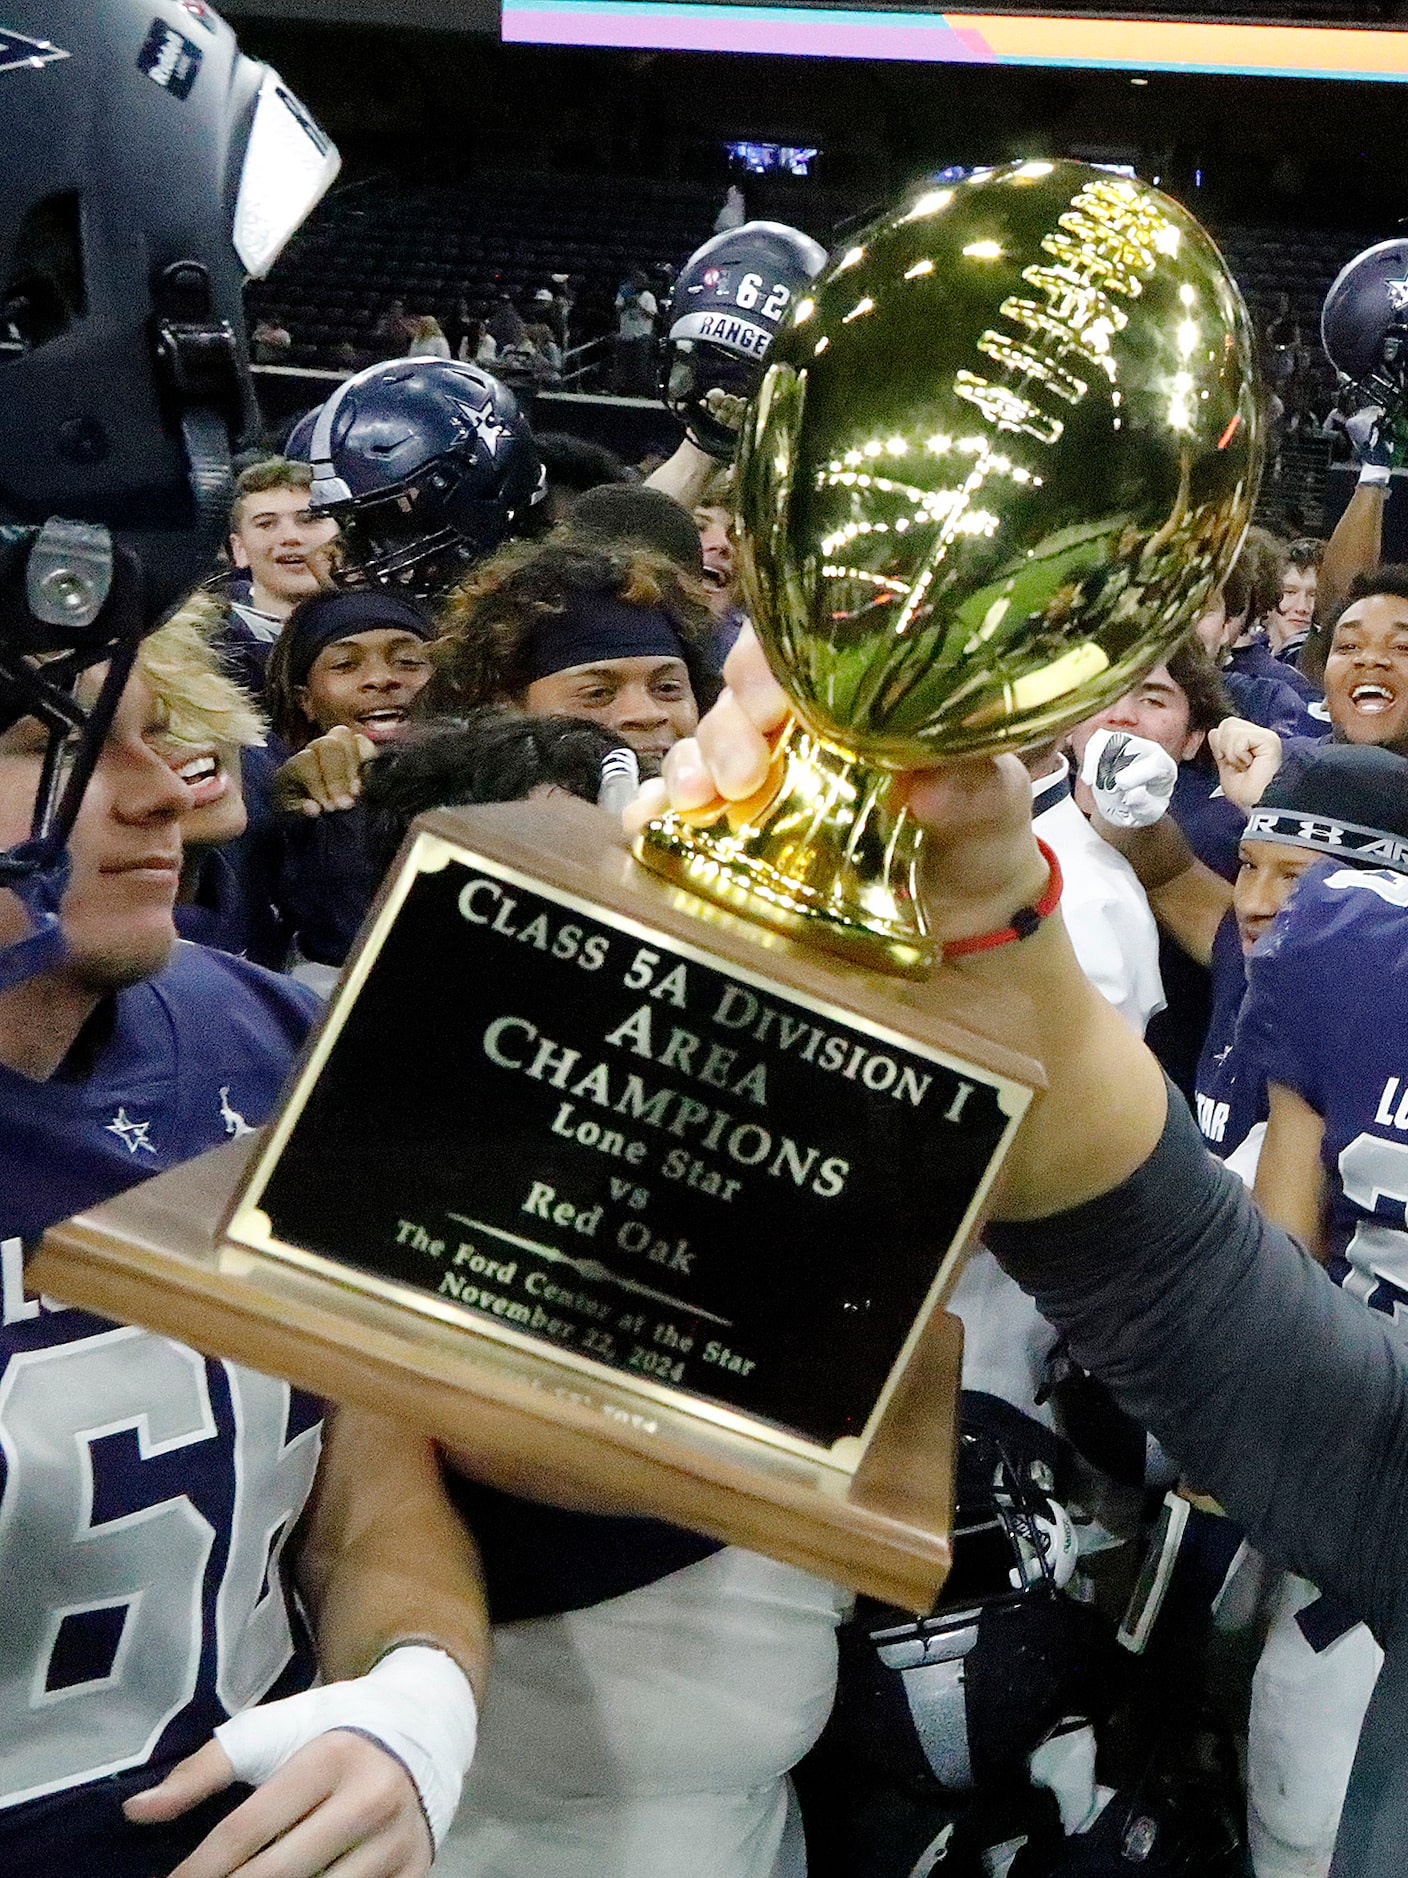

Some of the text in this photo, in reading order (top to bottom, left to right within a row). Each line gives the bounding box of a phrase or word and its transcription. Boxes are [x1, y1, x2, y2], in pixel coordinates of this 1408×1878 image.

[699, 315, 770, 356] RANGE
[735, 272, 790, 322] 62
[458, 878, 976, 1123] CLASS 5A DIVISION I
[604, 1004, 769, 1106] AREA
[483, 1015, 851, 1198] CHAMPIONS
[551, 1101, 743, 1203] Lone Star
[521, 1180, 697, 1276] Red Oak
[610, 1175, 651, 1210] vs
[396, 1219, 446, 1258] The
[452, 1242, 518, 1285] Ford
[652, 1322, 695, 1353] the
[702, 1340, 757, 1377] Star
[438, 1271, 577, 1338] November
[627, 1345, 687, 1383] 2024
